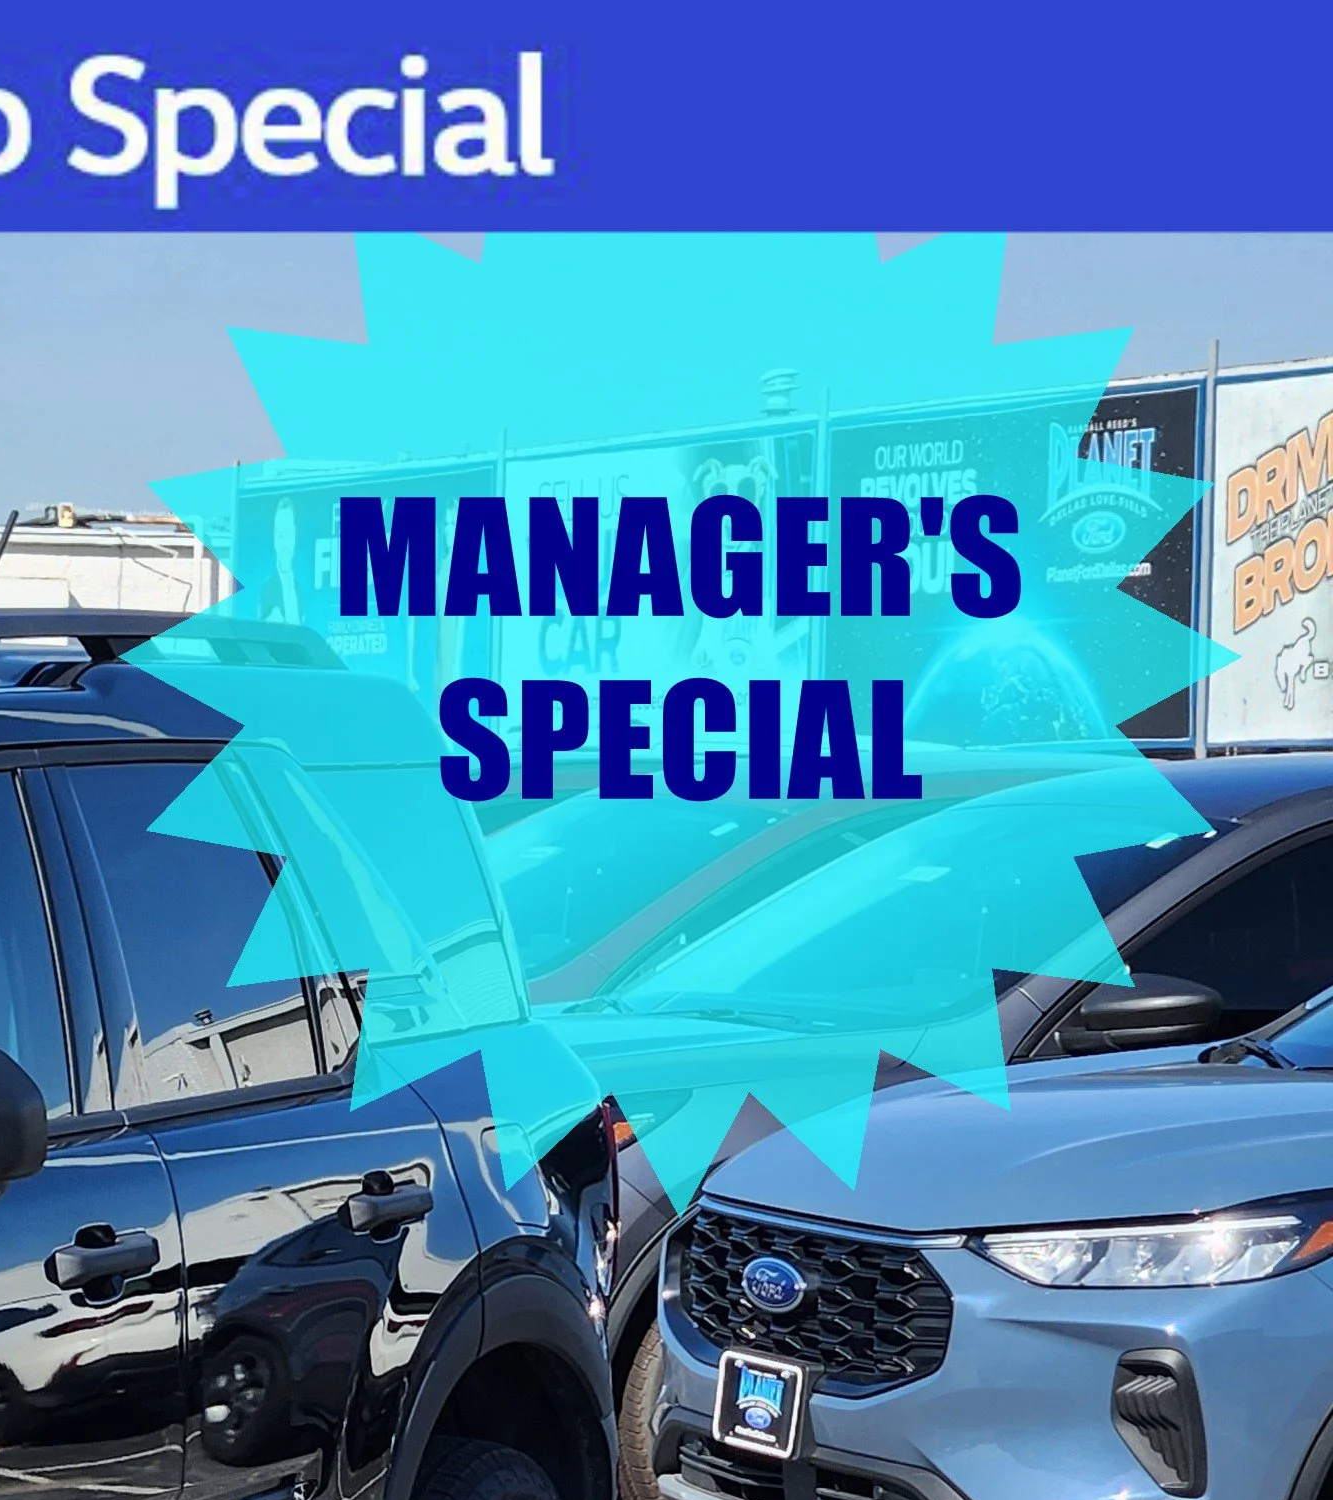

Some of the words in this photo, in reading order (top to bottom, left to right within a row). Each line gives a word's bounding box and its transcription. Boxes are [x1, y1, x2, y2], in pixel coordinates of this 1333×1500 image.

[875, 445, 906, 471] OUR
[910, 439, 964, 467] WORLD
[1048, 422, 1156, 511] PLANET
[861, 468, 978, 508] REVOLVES
[1233, 515, 1333, 635] BRO
